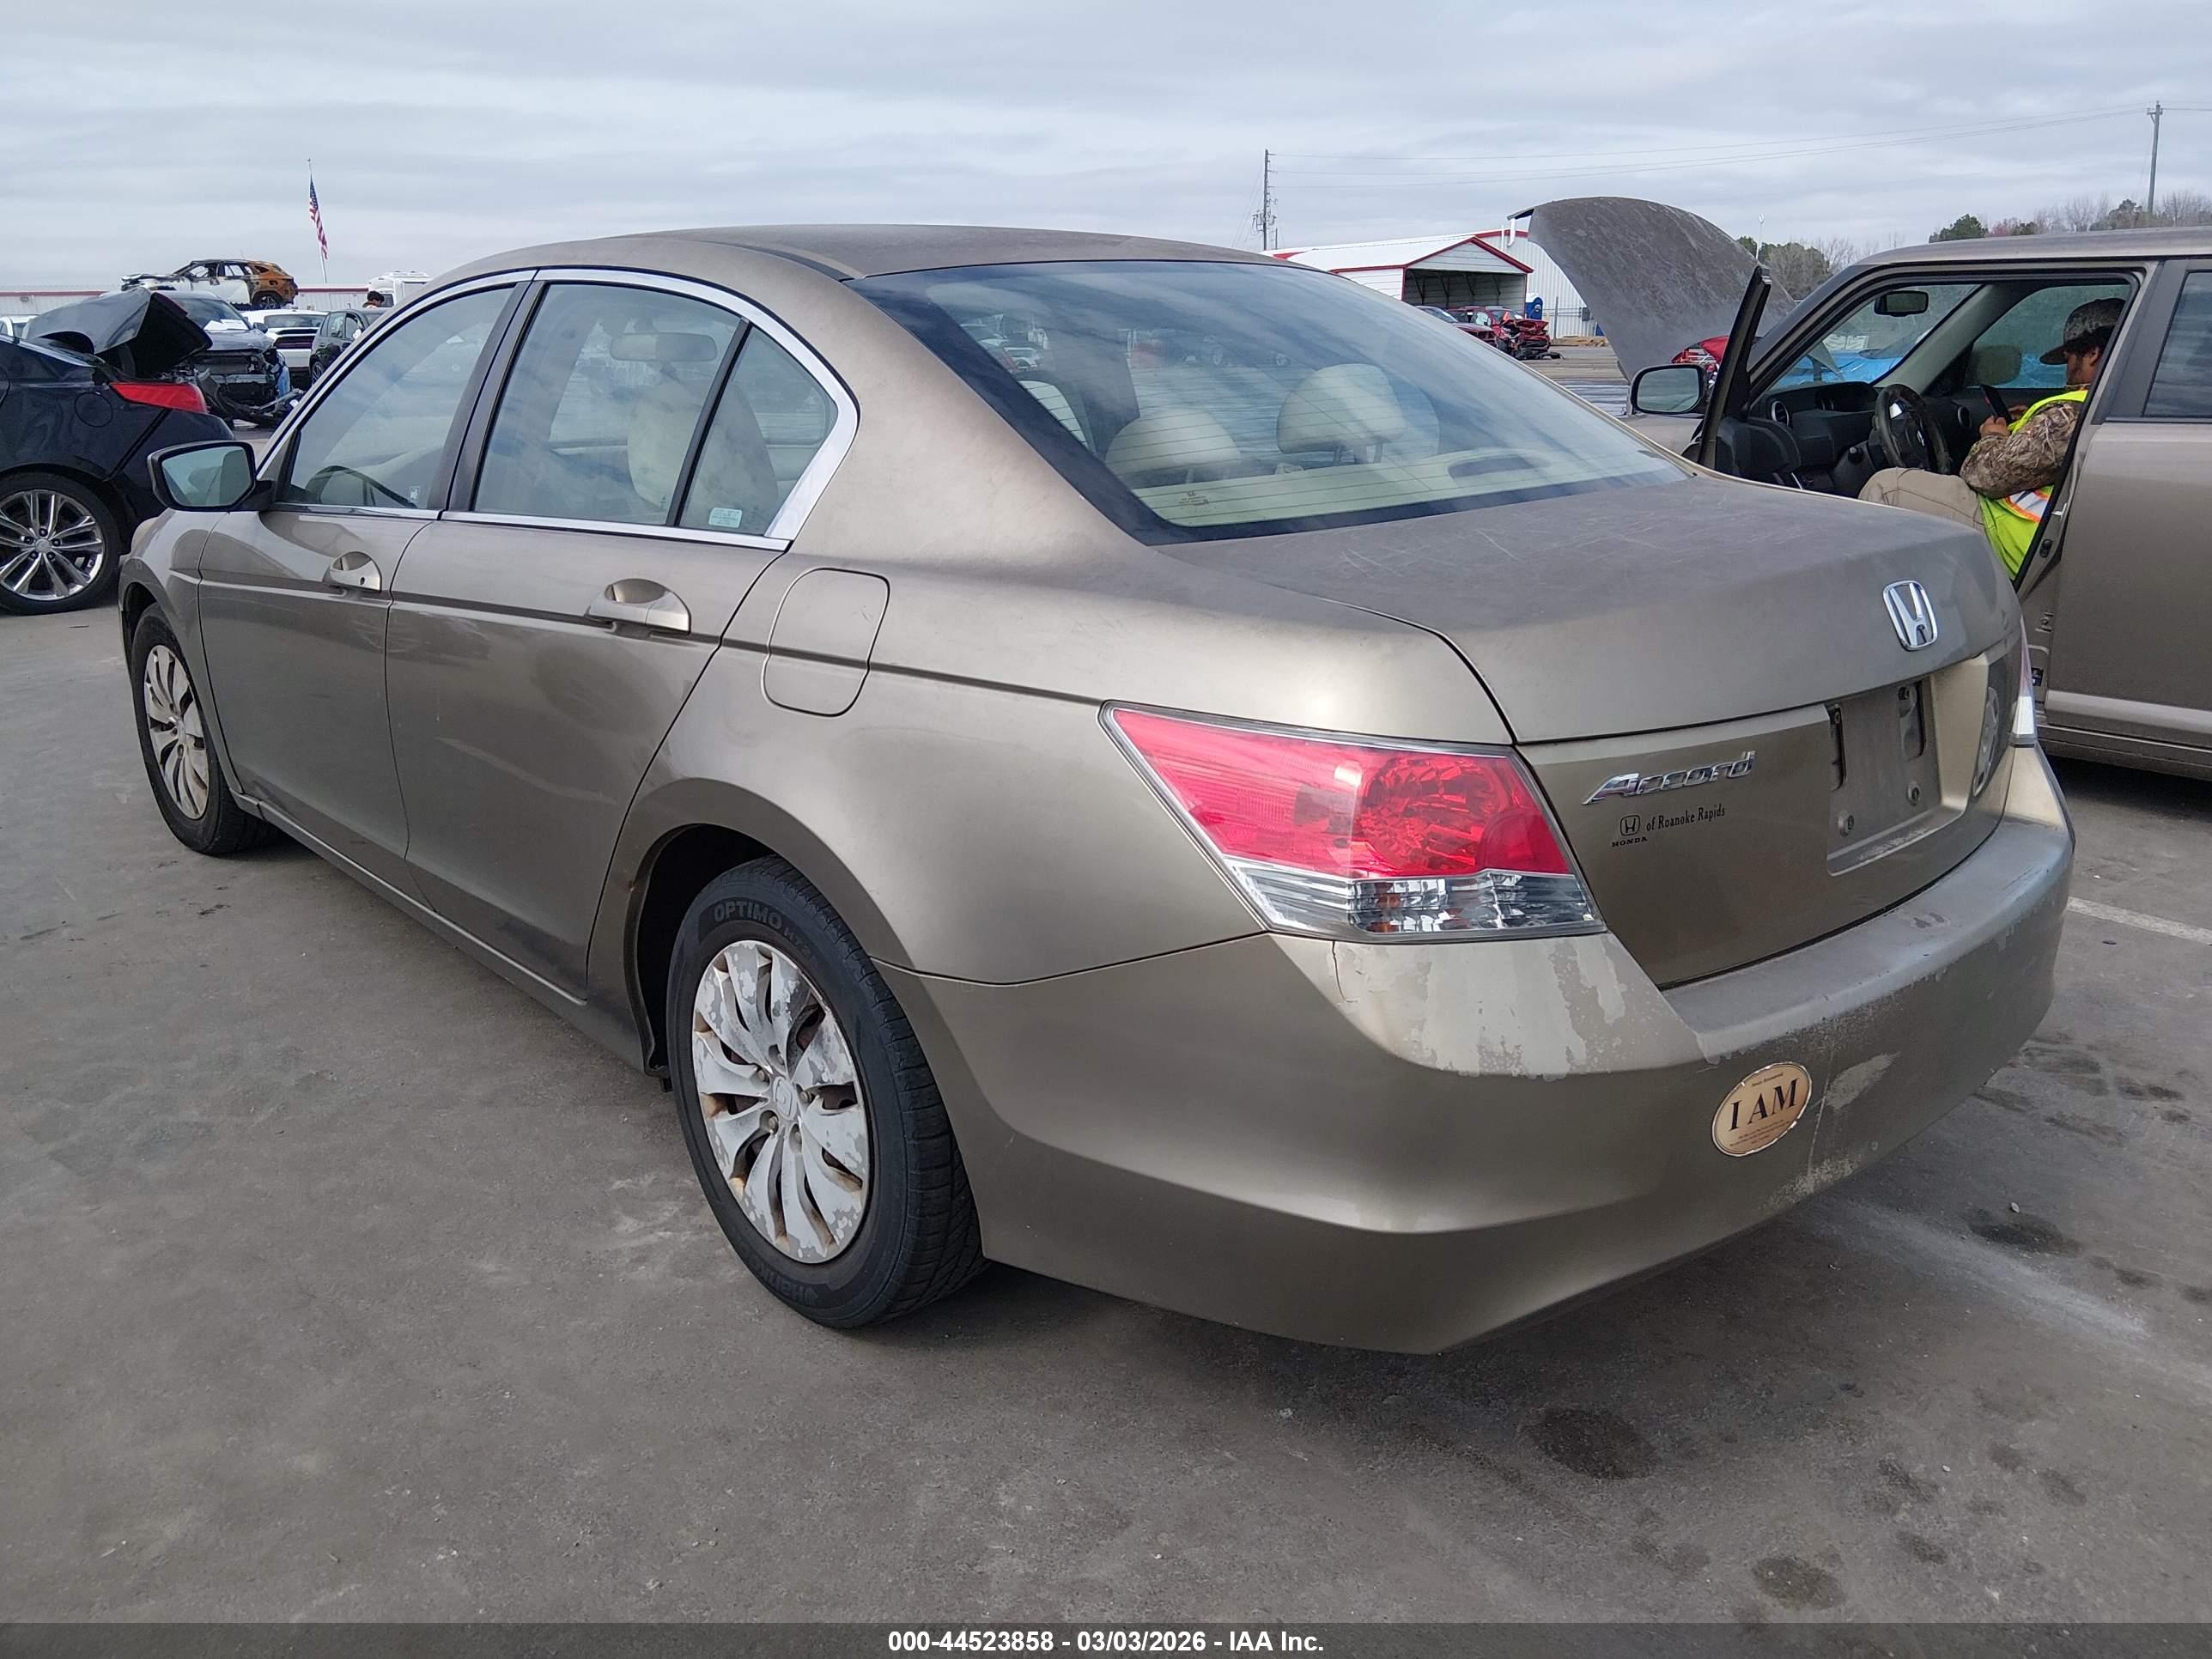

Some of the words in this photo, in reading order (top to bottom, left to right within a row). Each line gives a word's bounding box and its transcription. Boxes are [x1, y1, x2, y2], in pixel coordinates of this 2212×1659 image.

[1582, 750, 1756, 805] Accord
[1646, 817, 1656, 831] of
[1657, 810, 1695, 830] Roanoke
[1698, 803, 1725, 822] Rapids
[1612, 836, 1648, 848] HONDA
[714, 900, 782, 929] OPTIMO
[1729, 1099, 1741, 1132] I
[1747, 1079, 1799, 1125] AM
